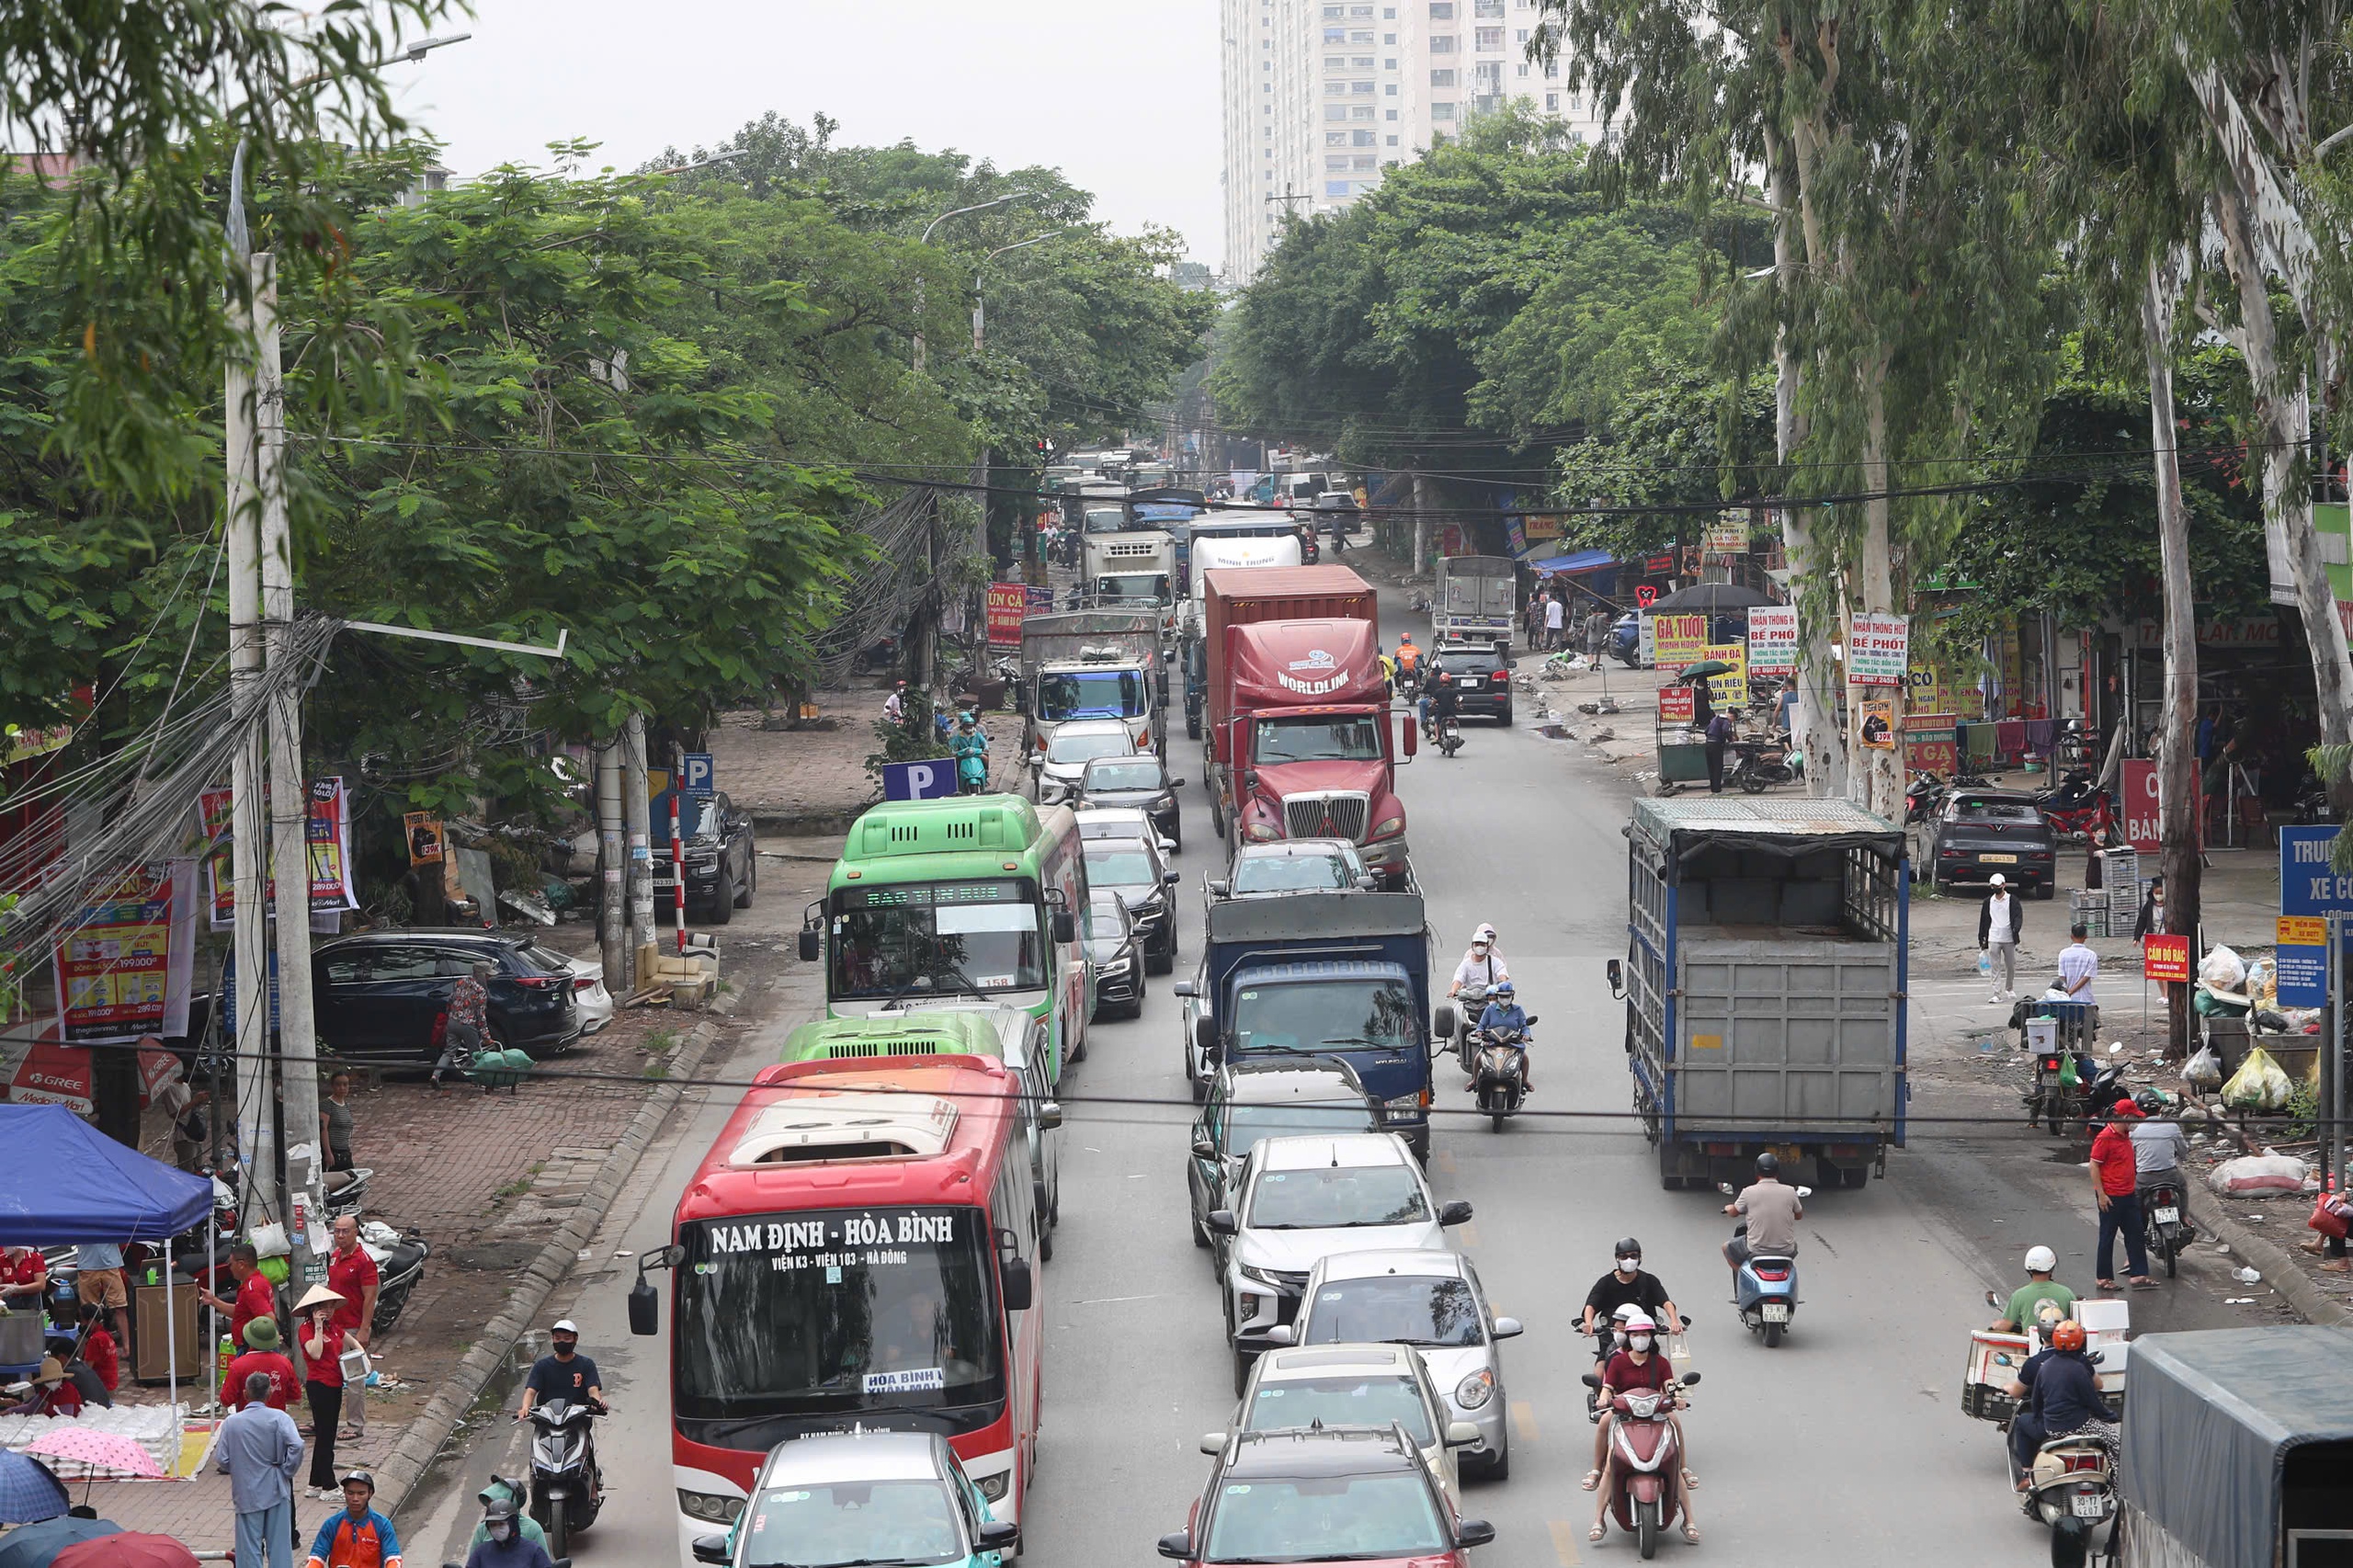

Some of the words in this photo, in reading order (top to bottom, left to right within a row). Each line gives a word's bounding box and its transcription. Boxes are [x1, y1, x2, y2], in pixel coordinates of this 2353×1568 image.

[1277, 668, 1349, 695] WORLDLINK
[689, 760, 709, 786] P
[906, 765, 935, 800] P
[2310, 877, 2331, 900] XE
[43, 1074, 84, 1090] GREE
[711, 1224, 762, 1254] NAM
[767, 1221, 825, 1254] ĐỊNH
[844, 1211, 894, 1245] HÒA
[897, 1210, 954, 1243] BÌNH
[772, 1255, 794, 1272] VIỆN
[796, 1256, 808, 1269] K3
[839, 1252, 857, 1267] 103
[866, 1251, 880, 1266] HÀ
[881, 1250, 907, 1265] ĐÔNG
[573, 1372, 584, 1388] B
[869, 1373, 897, 1387] HÒA
[900, 1369, 935, 1383] BÌNH
